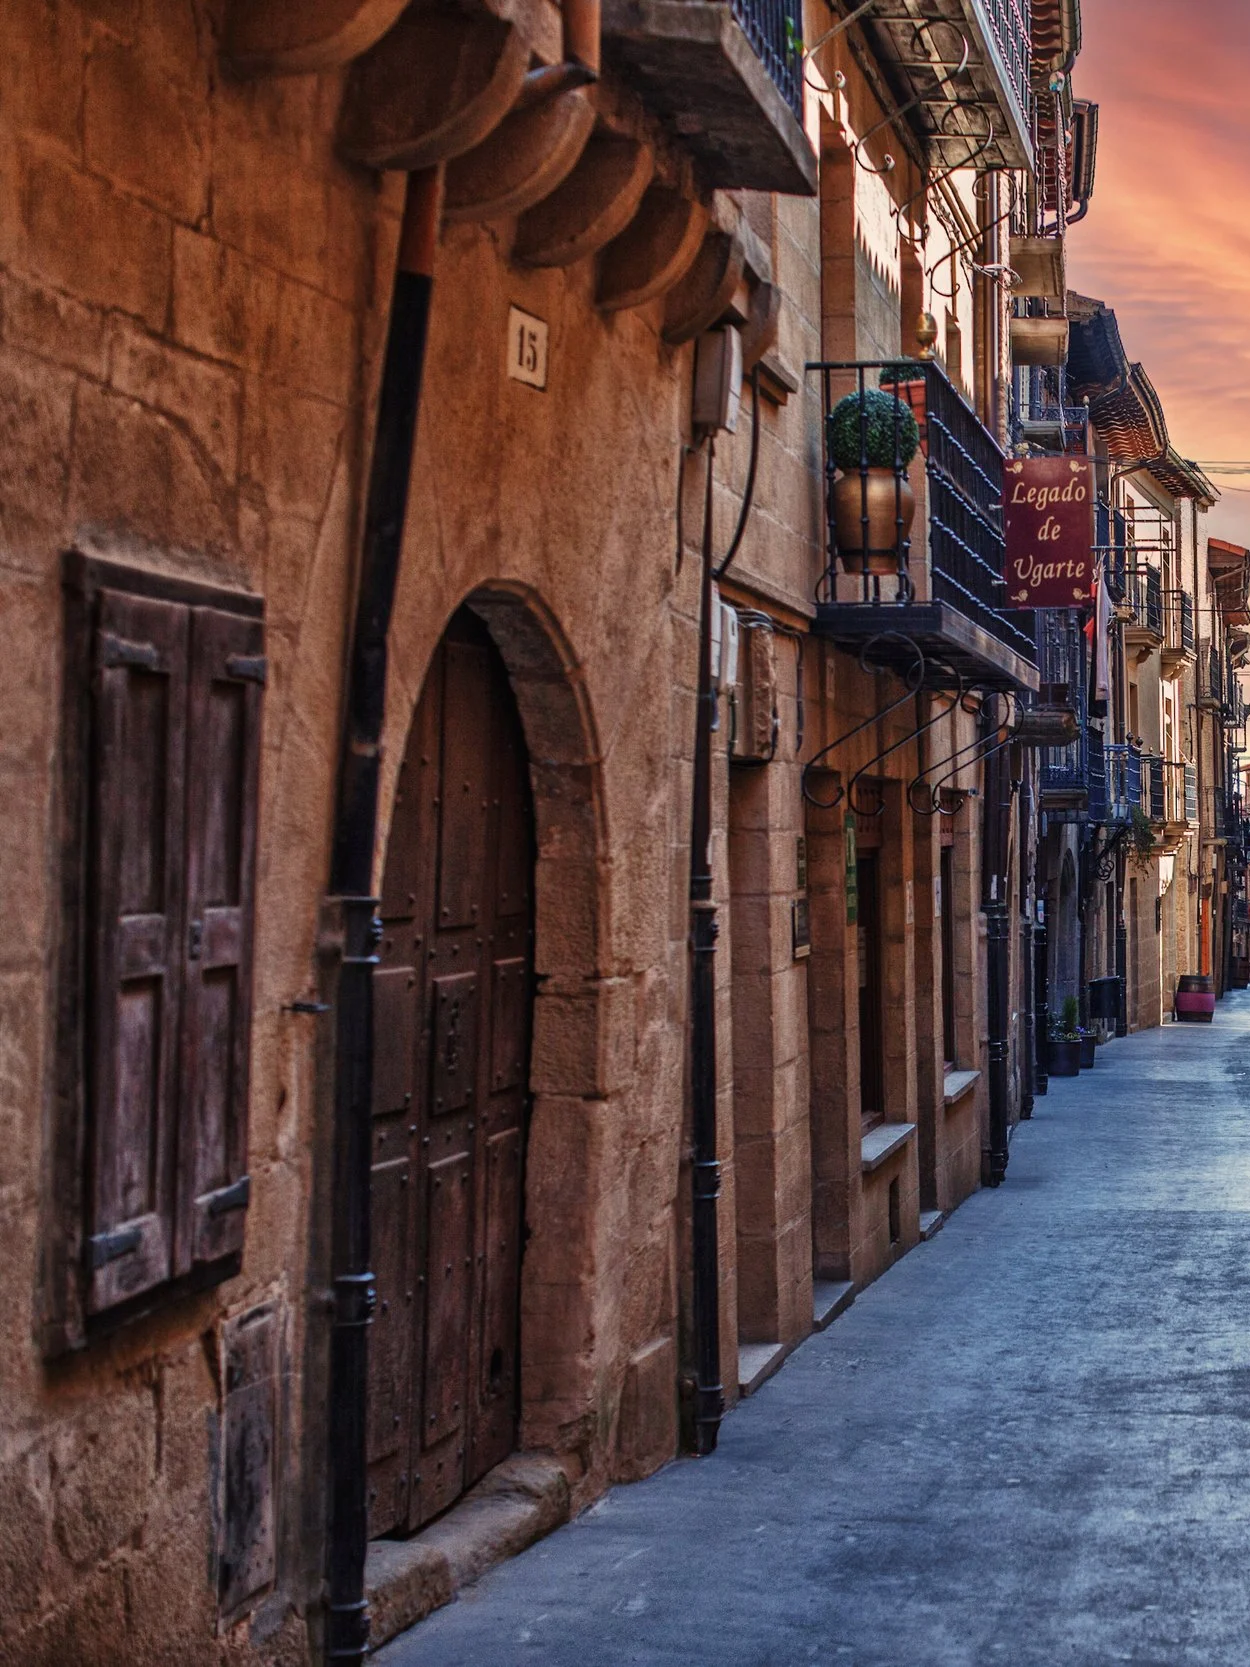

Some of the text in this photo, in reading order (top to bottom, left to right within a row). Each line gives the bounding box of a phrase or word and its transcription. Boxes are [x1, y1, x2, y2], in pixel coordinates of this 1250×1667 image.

[518, 324, 538, 373] 15
[1010, 477, 1086, 511] Legado
[1037, 516, 1061, 541] de
[1013, 554, 1086, 587] Ugarte
